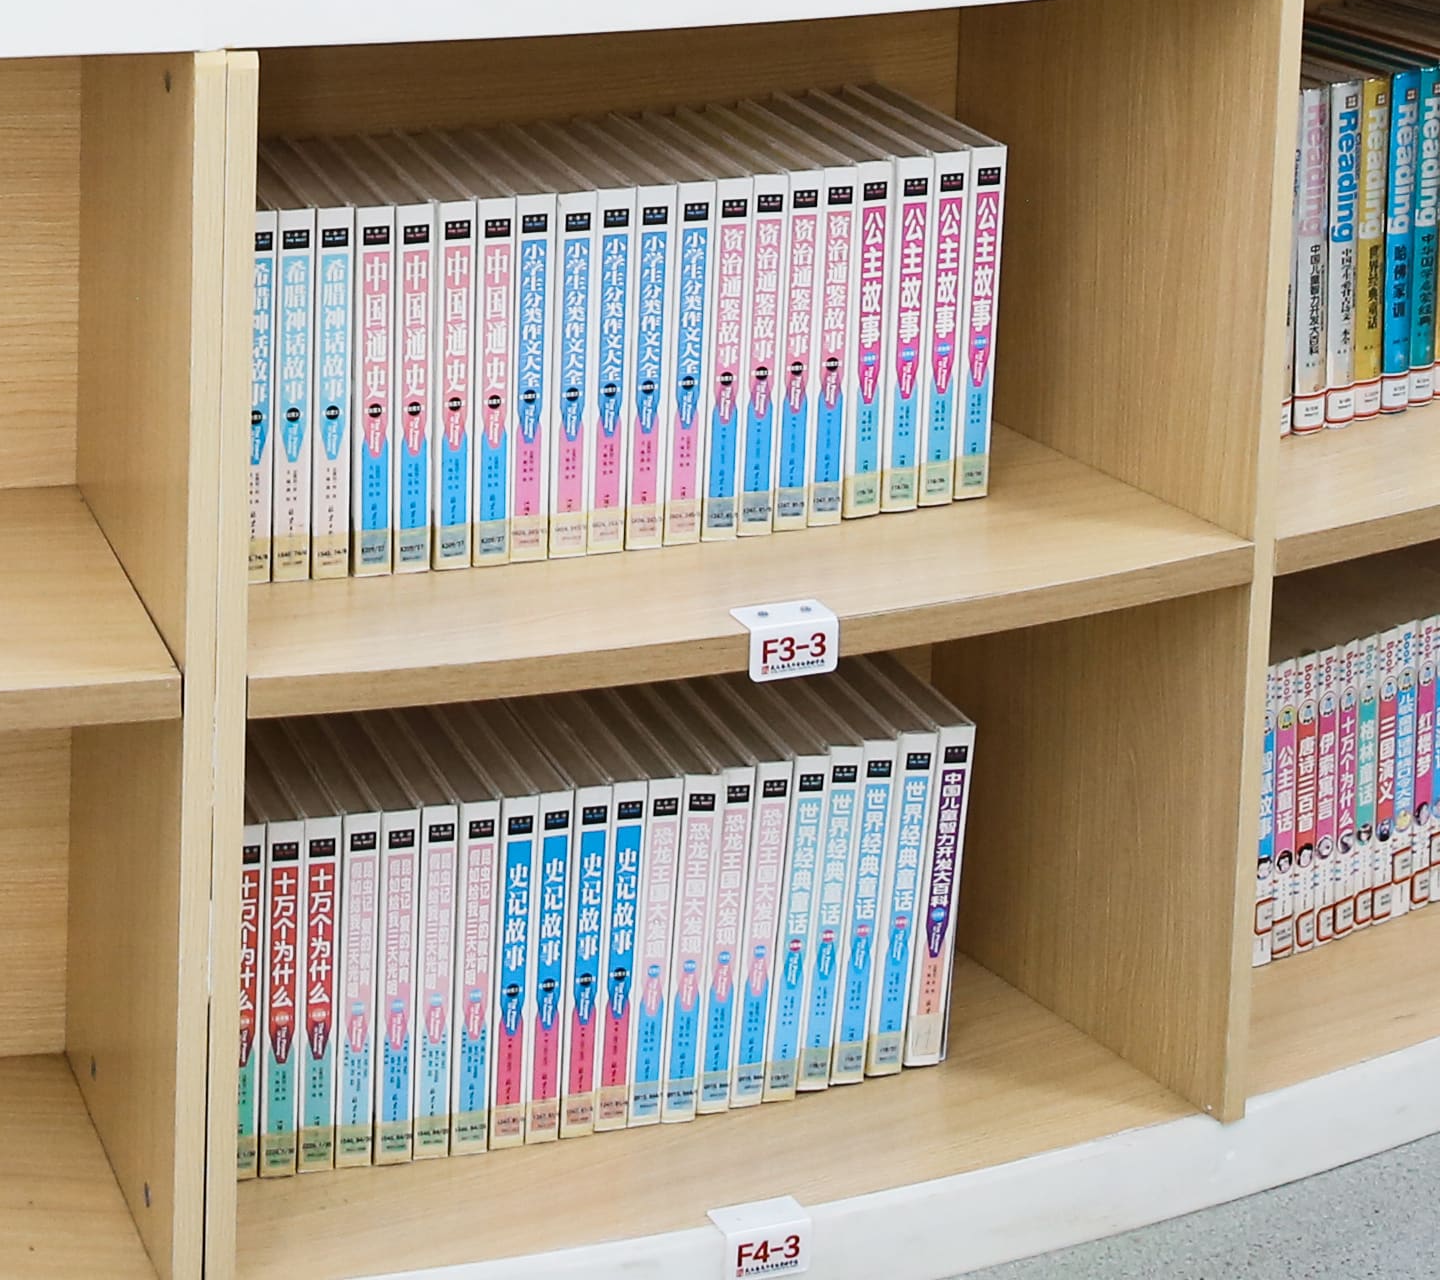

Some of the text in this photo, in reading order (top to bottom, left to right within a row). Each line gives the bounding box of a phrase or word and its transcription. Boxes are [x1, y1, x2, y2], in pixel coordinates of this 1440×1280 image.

[1301, 103, 1326, 237] Reading
[1330, 108, 1359, 244] Reading
[1359, 108, 1387, 239] Reading
[1388, 104, 1418, 235] Reading
[323, 259, 346, 401] 希腊神话故事
[364, 256, 387, 399] 中国通史
[404, 255, 427, 398] 中国通史
[445, 251, 468, 393] 中国通史
[485, 249, 508, 390] 中国通史
[522, 244, 546, 388] 小学生分类作文大全
[564, 242, 589, 386] 小学生分类作文大全
[602, 238, 627, 382] 小学生分类作文大全
[641, 235, 666, 378] 小学生分类作文大全
[718, 229, 743, 368] 资治通鉴故事
[753, 224, 779, 363] 资治通鉴故事
[789, 219, 814, 357] 资治通鉴故事
[824, 215, 850, 352] 资治通鉴故事
[860, 212, 885, 348] 公主故事
[898, 208, 925, 343] 公主故事
[935, 202, 960, 339] 公主故事
[971, 198, 997, 331] 公主故事
[1392, 246, 1406, 318] 哈佛家训
[283, 260, 307, 403] 希腊神话故事
[763, 632, 826, 664] F3-3
[1276, 745, 1293, 833] 公主童话
[1298, 736, 1315, 833] 唐诗三百首
[1339, 716, 1355, 829] 十万个为什么
[1378, 716, 1395, 804] 三国演义
[1416, 712, 1432, 778] 红楼梦
[579, 853, 601, 960] 史记故事
[614, 847, 637, 954] 史记故事
[647, 827, 674, 958] 恐龙王国大发现
[682, 822, 710, 954] 恐龙王国大发现
[716, 814, 745, 945] 恐龙王国大发现
[752, 807, 783, 939] 恐龙王国大发现
[788, 804, 819, 936] 世界经典童话
[821, 794, 852, 926] 世界经典童话
[856, 789, 887, 920] 世界经典童话
[894, 780, 926, 911] 世界经典童话
[930, 772, 962, 908] 中国儿童智力开发大百科
[272, 872, 295, 1008] 十万个为什么
[309, 868, 333, 1005] 十万个为什么
[505, 863, 528, 971] 史记故事
[541, 858, 564, 966] 史记故事
[737, 1234, 800, 1267] F4-3
